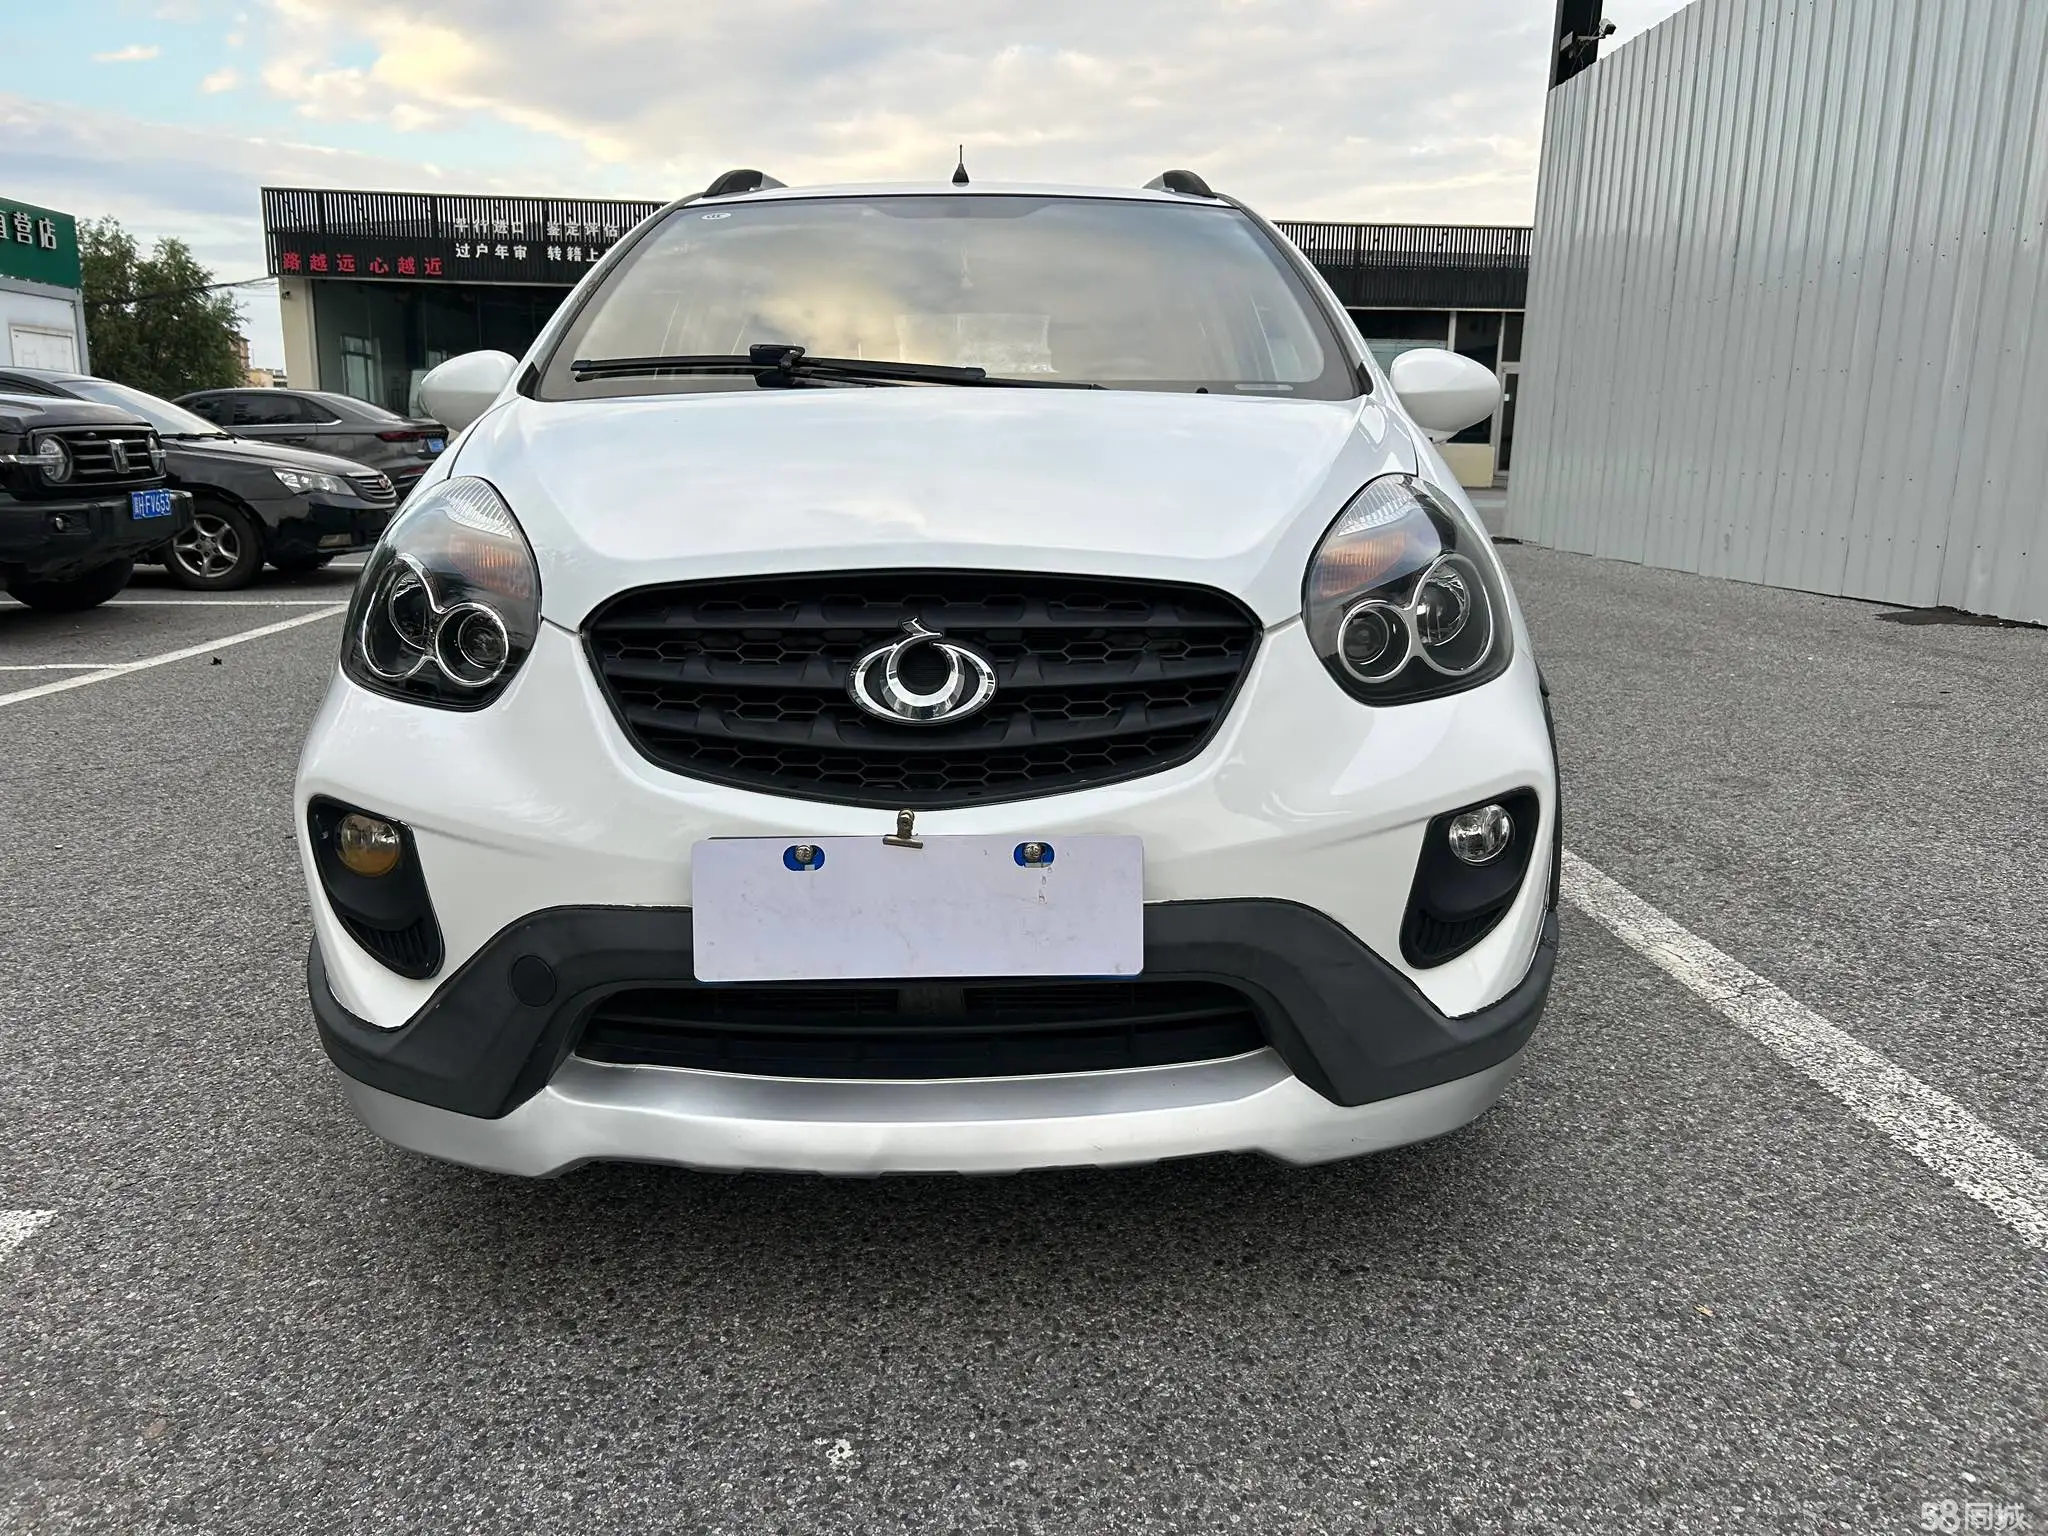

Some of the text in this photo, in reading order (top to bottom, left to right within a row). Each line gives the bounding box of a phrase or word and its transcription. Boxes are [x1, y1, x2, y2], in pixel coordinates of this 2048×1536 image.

[547, 220, 619, 238] 鉴定评估
[455, 242, 610, 262] 过户年审 转籍上
[283, 252, 443, 275] 路越远 心越近
